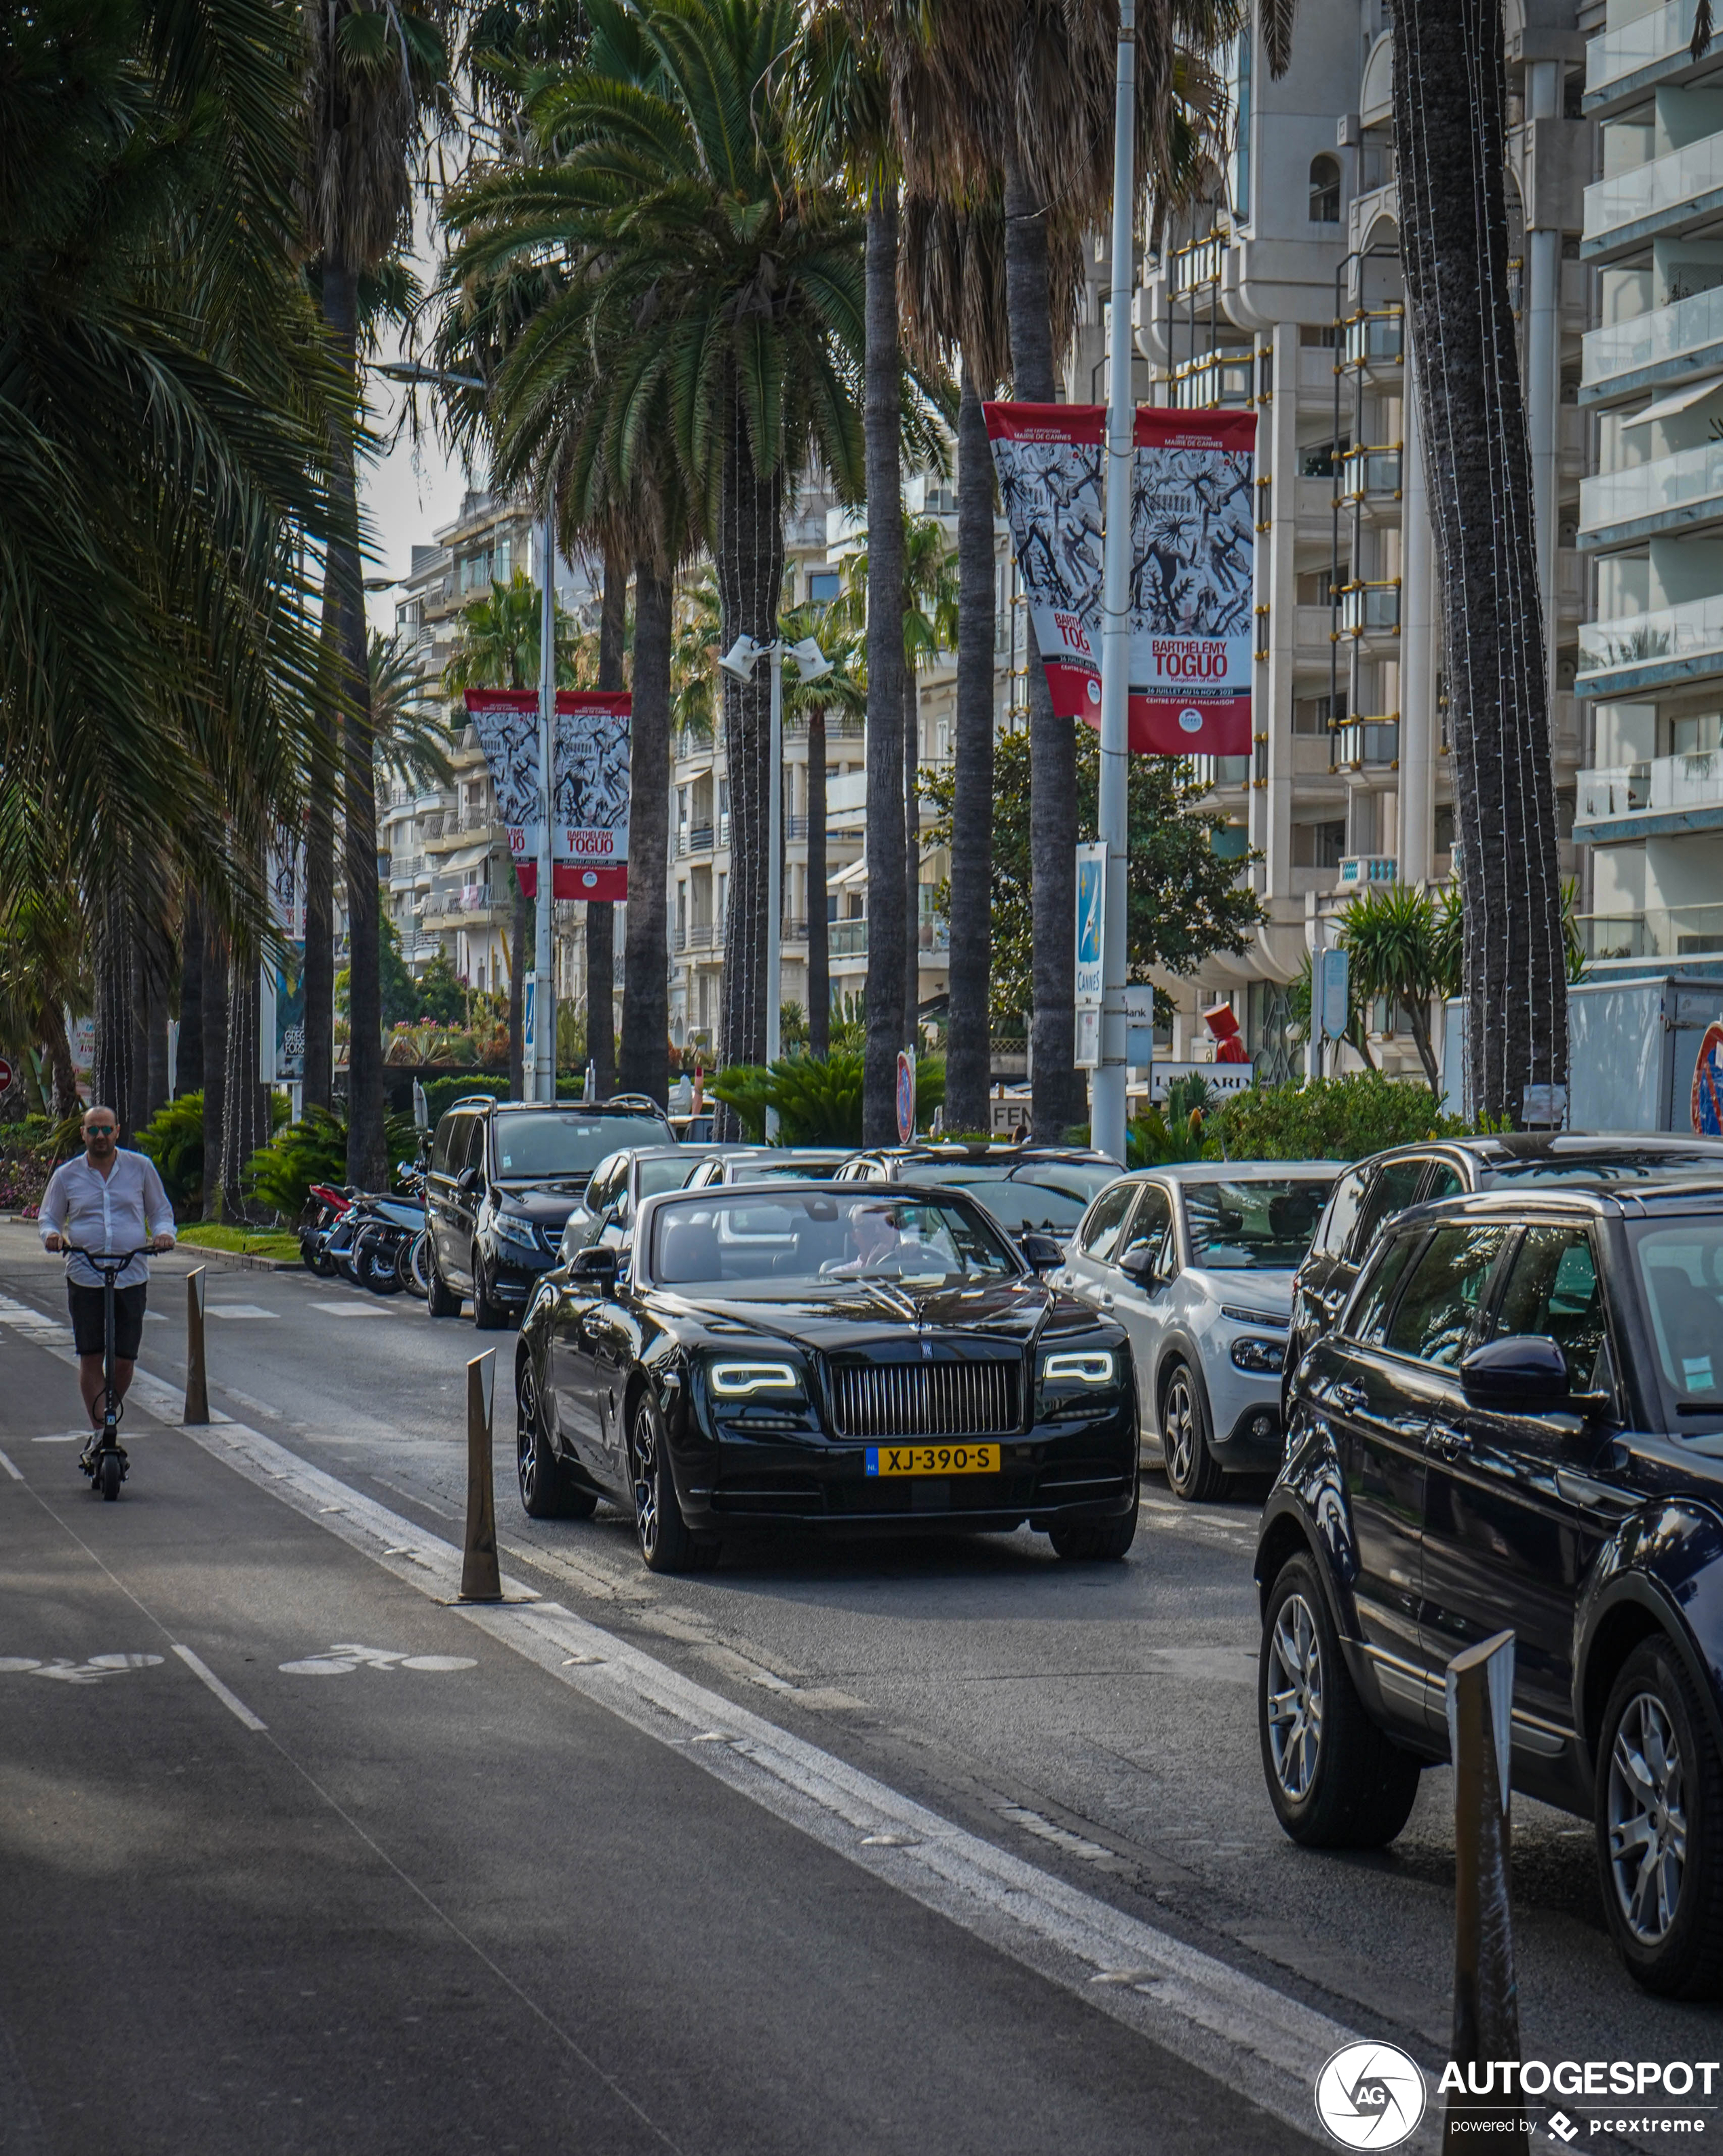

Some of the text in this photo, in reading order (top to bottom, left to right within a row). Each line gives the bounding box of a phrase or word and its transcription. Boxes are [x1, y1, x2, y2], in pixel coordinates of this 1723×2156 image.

[1013, 432, 1034, 440] MAIRIE
[1197, 440, 1224, 448] CANNES
[1152, 639, 1228, 655] BARTHÉLÉMY
[1152, 653, 1228, 678] TOGUO
[1156, 687, 1181, 695] JUILLET
[1146, 697, 1169, 705] CENTRE
[1197, 698, 1235, 706] MALMAISON
[566, 838, 614, 853] TOGUO
[1077, 970, 1100, 993] CANNES
[887, 1447, 990, 1471] XJ-390-S
